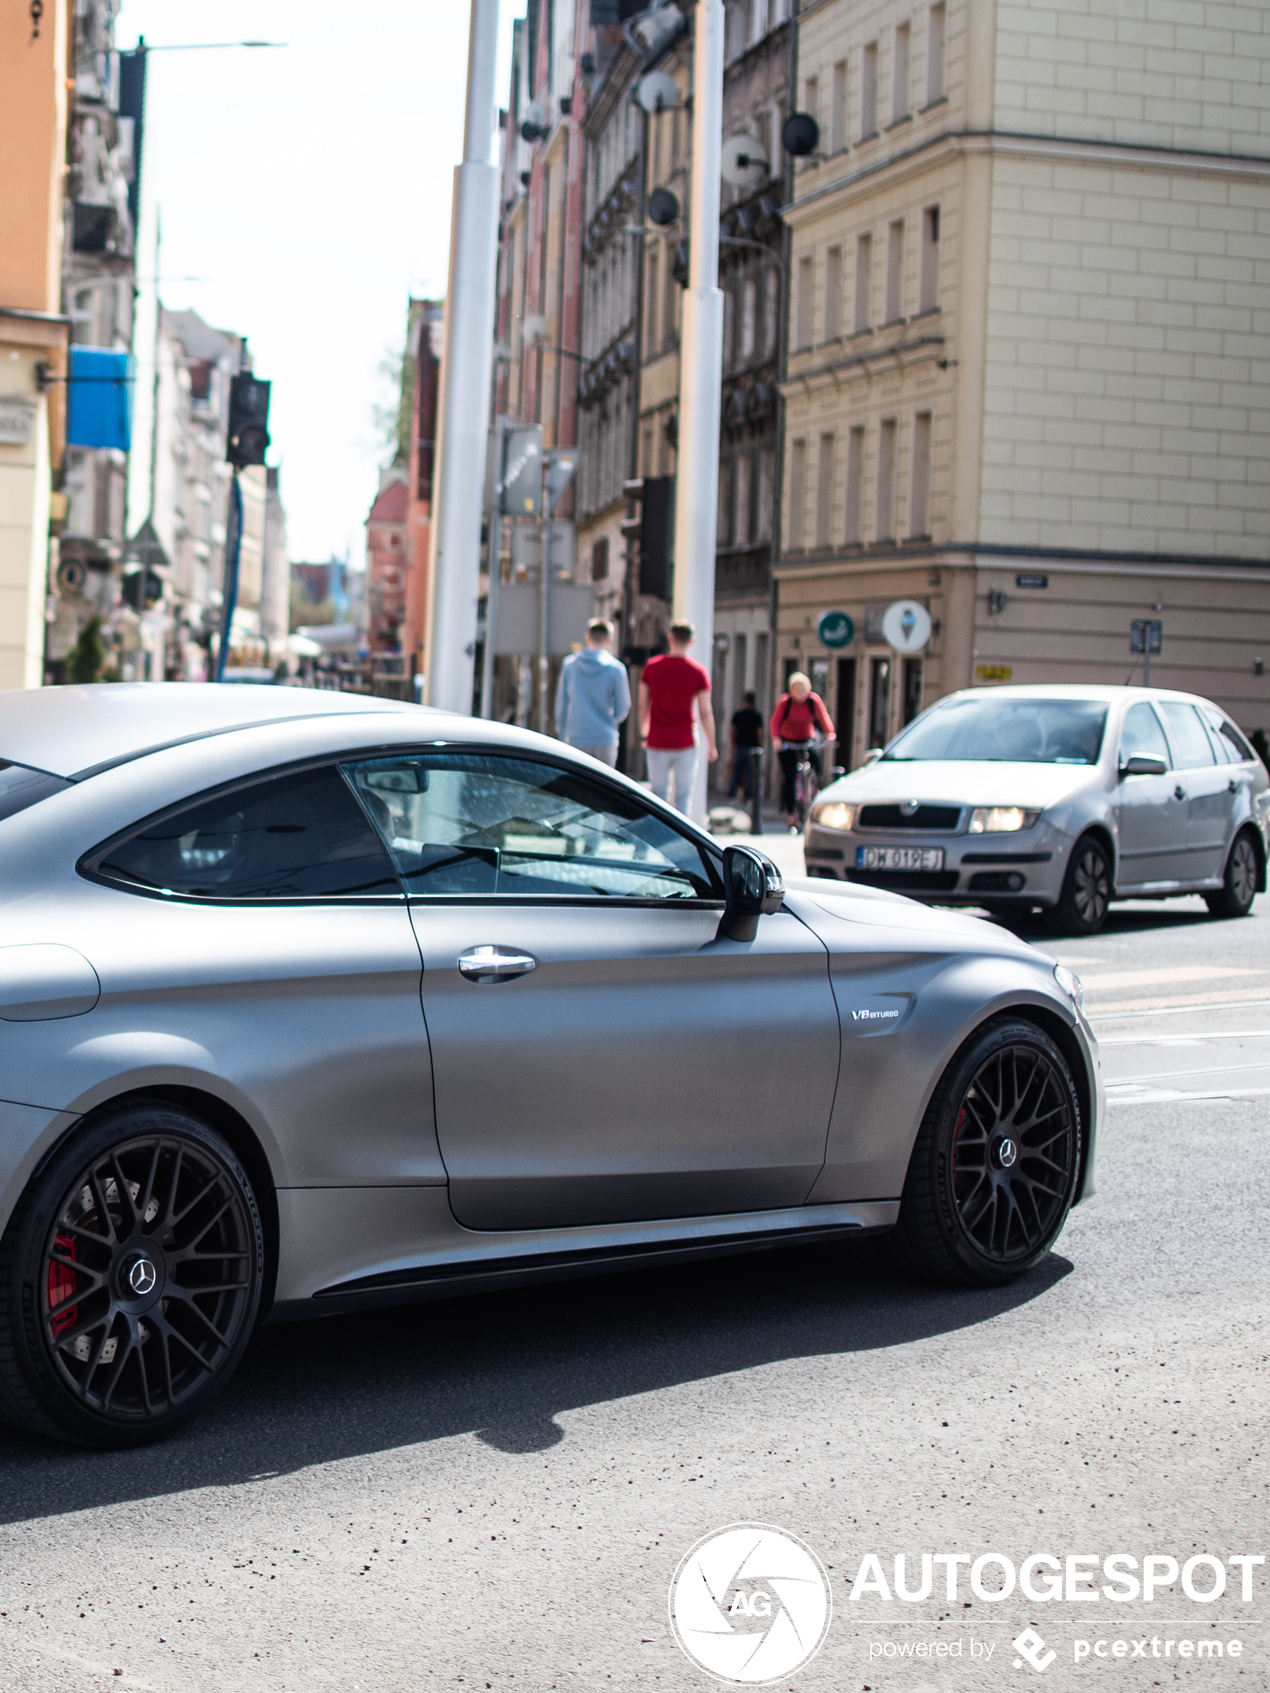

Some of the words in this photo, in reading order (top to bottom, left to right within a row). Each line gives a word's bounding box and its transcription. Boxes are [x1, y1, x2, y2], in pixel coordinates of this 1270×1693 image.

[866, 848, 887, 867] DW
[244, 1185, 263, 1271] MICHELIN
[23, 1286, 47, 1373] MICHELIN
